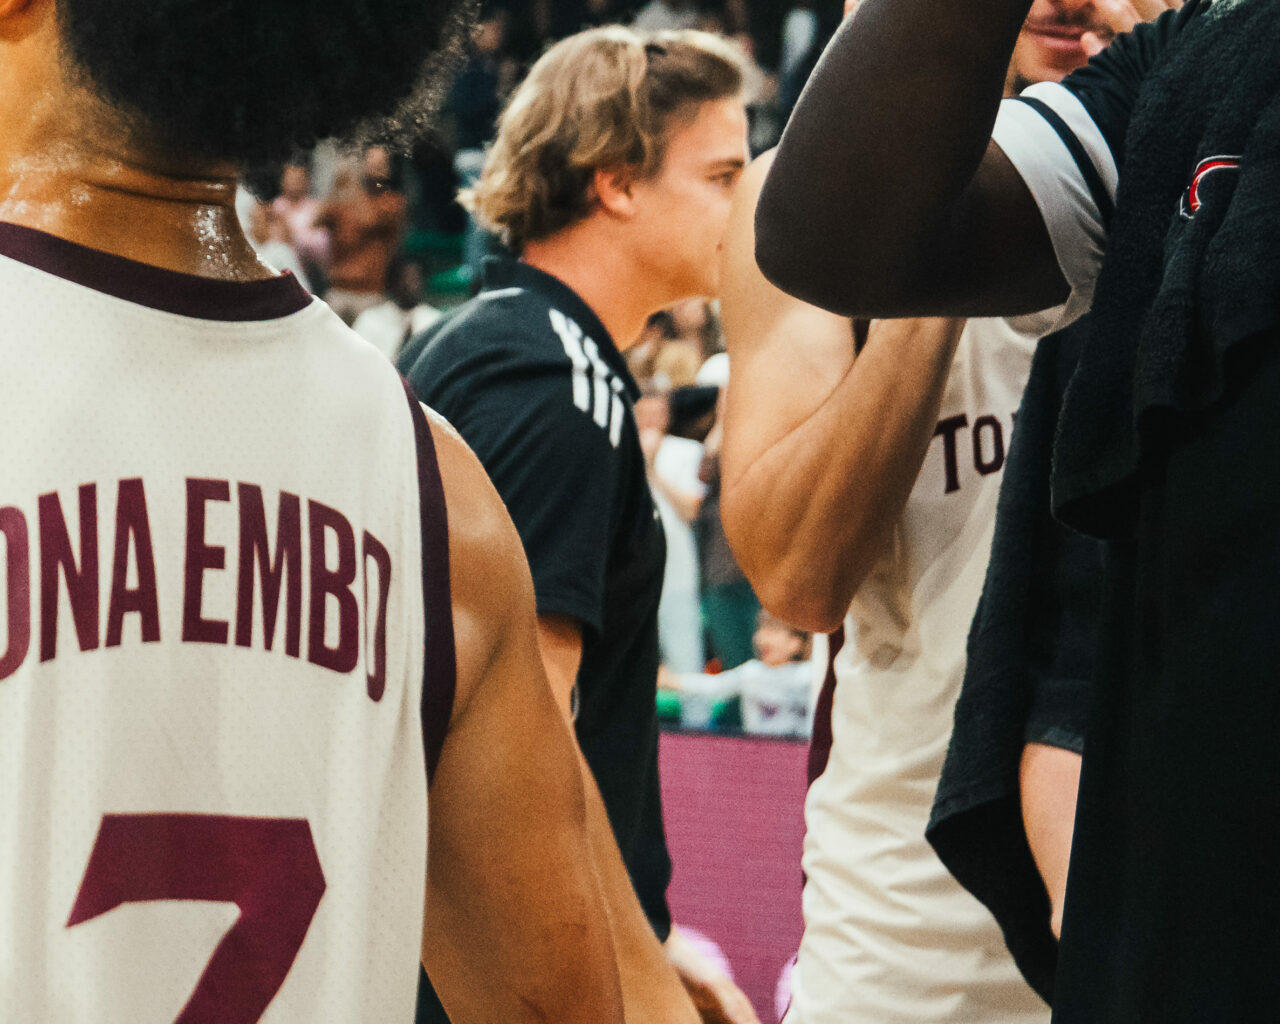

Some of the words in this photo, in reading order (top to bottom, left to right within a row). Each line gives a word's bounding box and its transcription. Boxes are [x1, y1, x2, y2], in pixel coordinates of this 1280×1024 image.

[932, 413, 1019, 494] TO
[182, 477, 391, 703] EMBO
[65, 812, 327, 1024] 7
